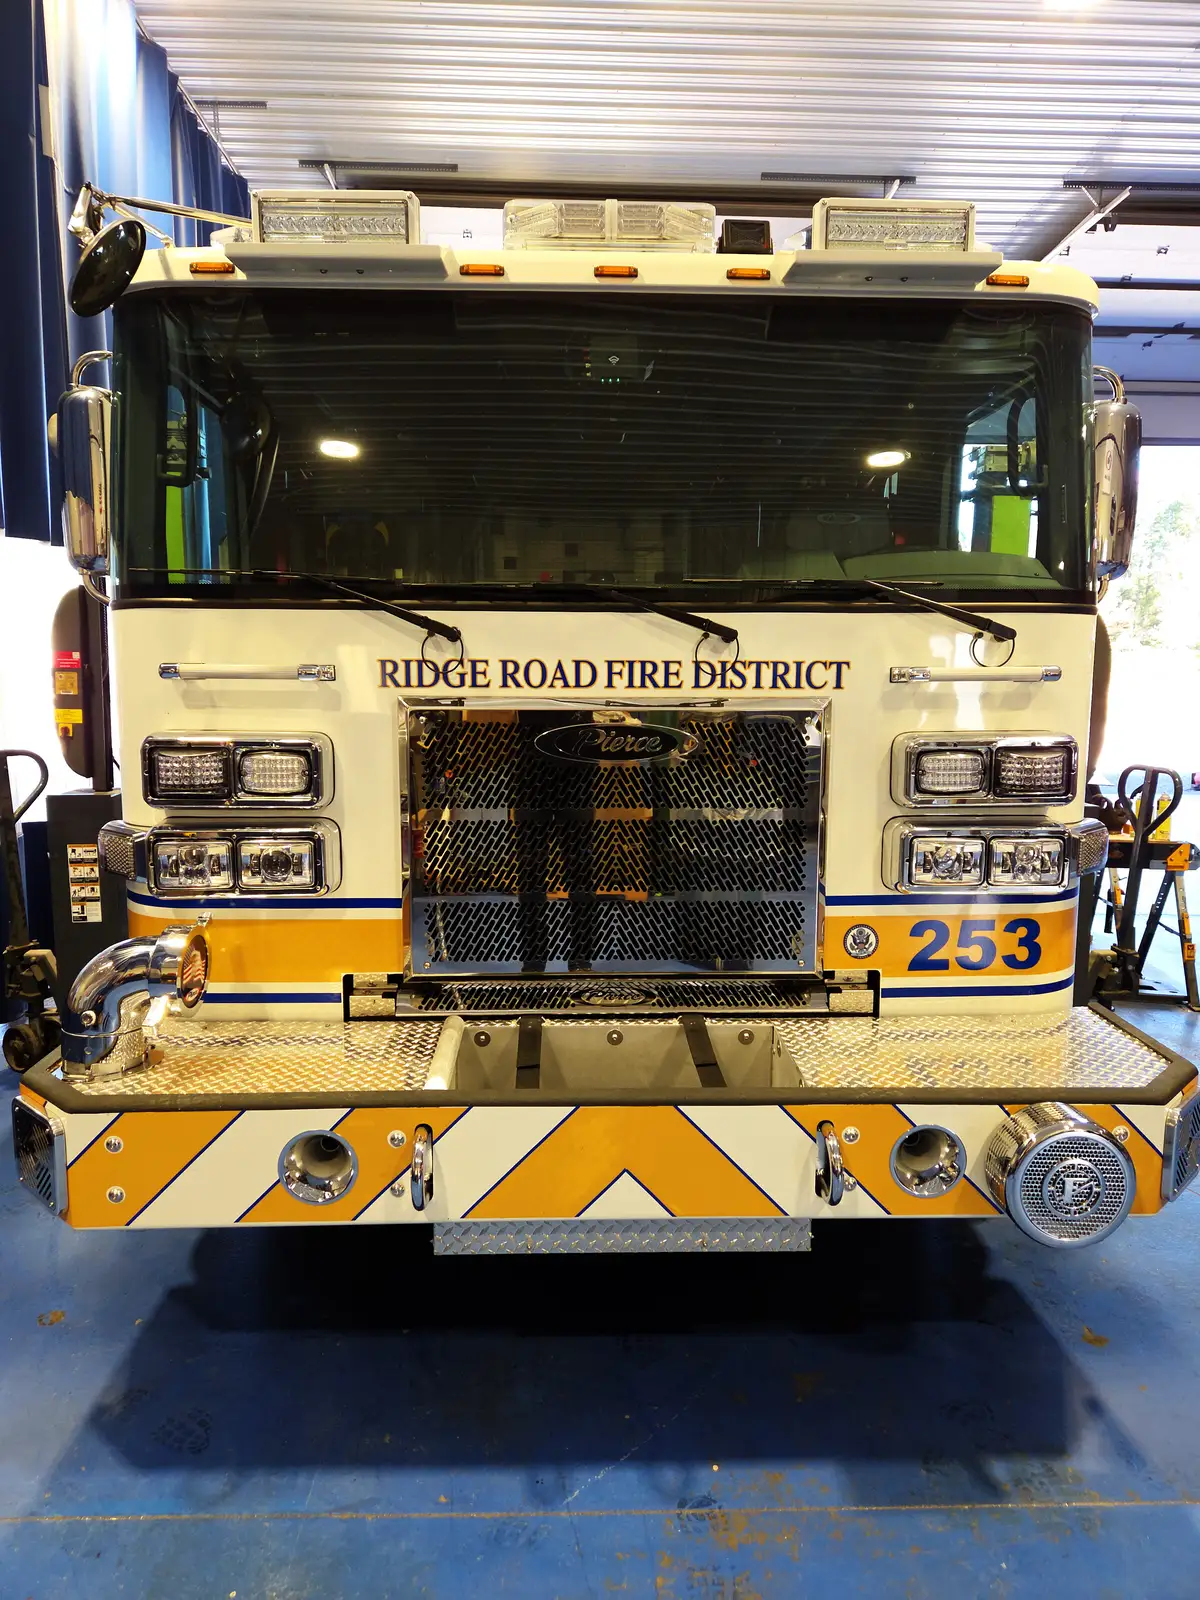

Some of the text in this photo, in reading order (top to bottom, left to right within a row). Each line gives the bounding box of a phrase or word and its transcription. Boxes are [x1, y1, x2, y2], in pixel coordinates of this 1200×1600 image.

[377, 659, 851, 690] RIDGE ROAD FIRE DISTRICT
[572, 728, 663, 756] Pierce
[907, 917, 1043, 972] 253
